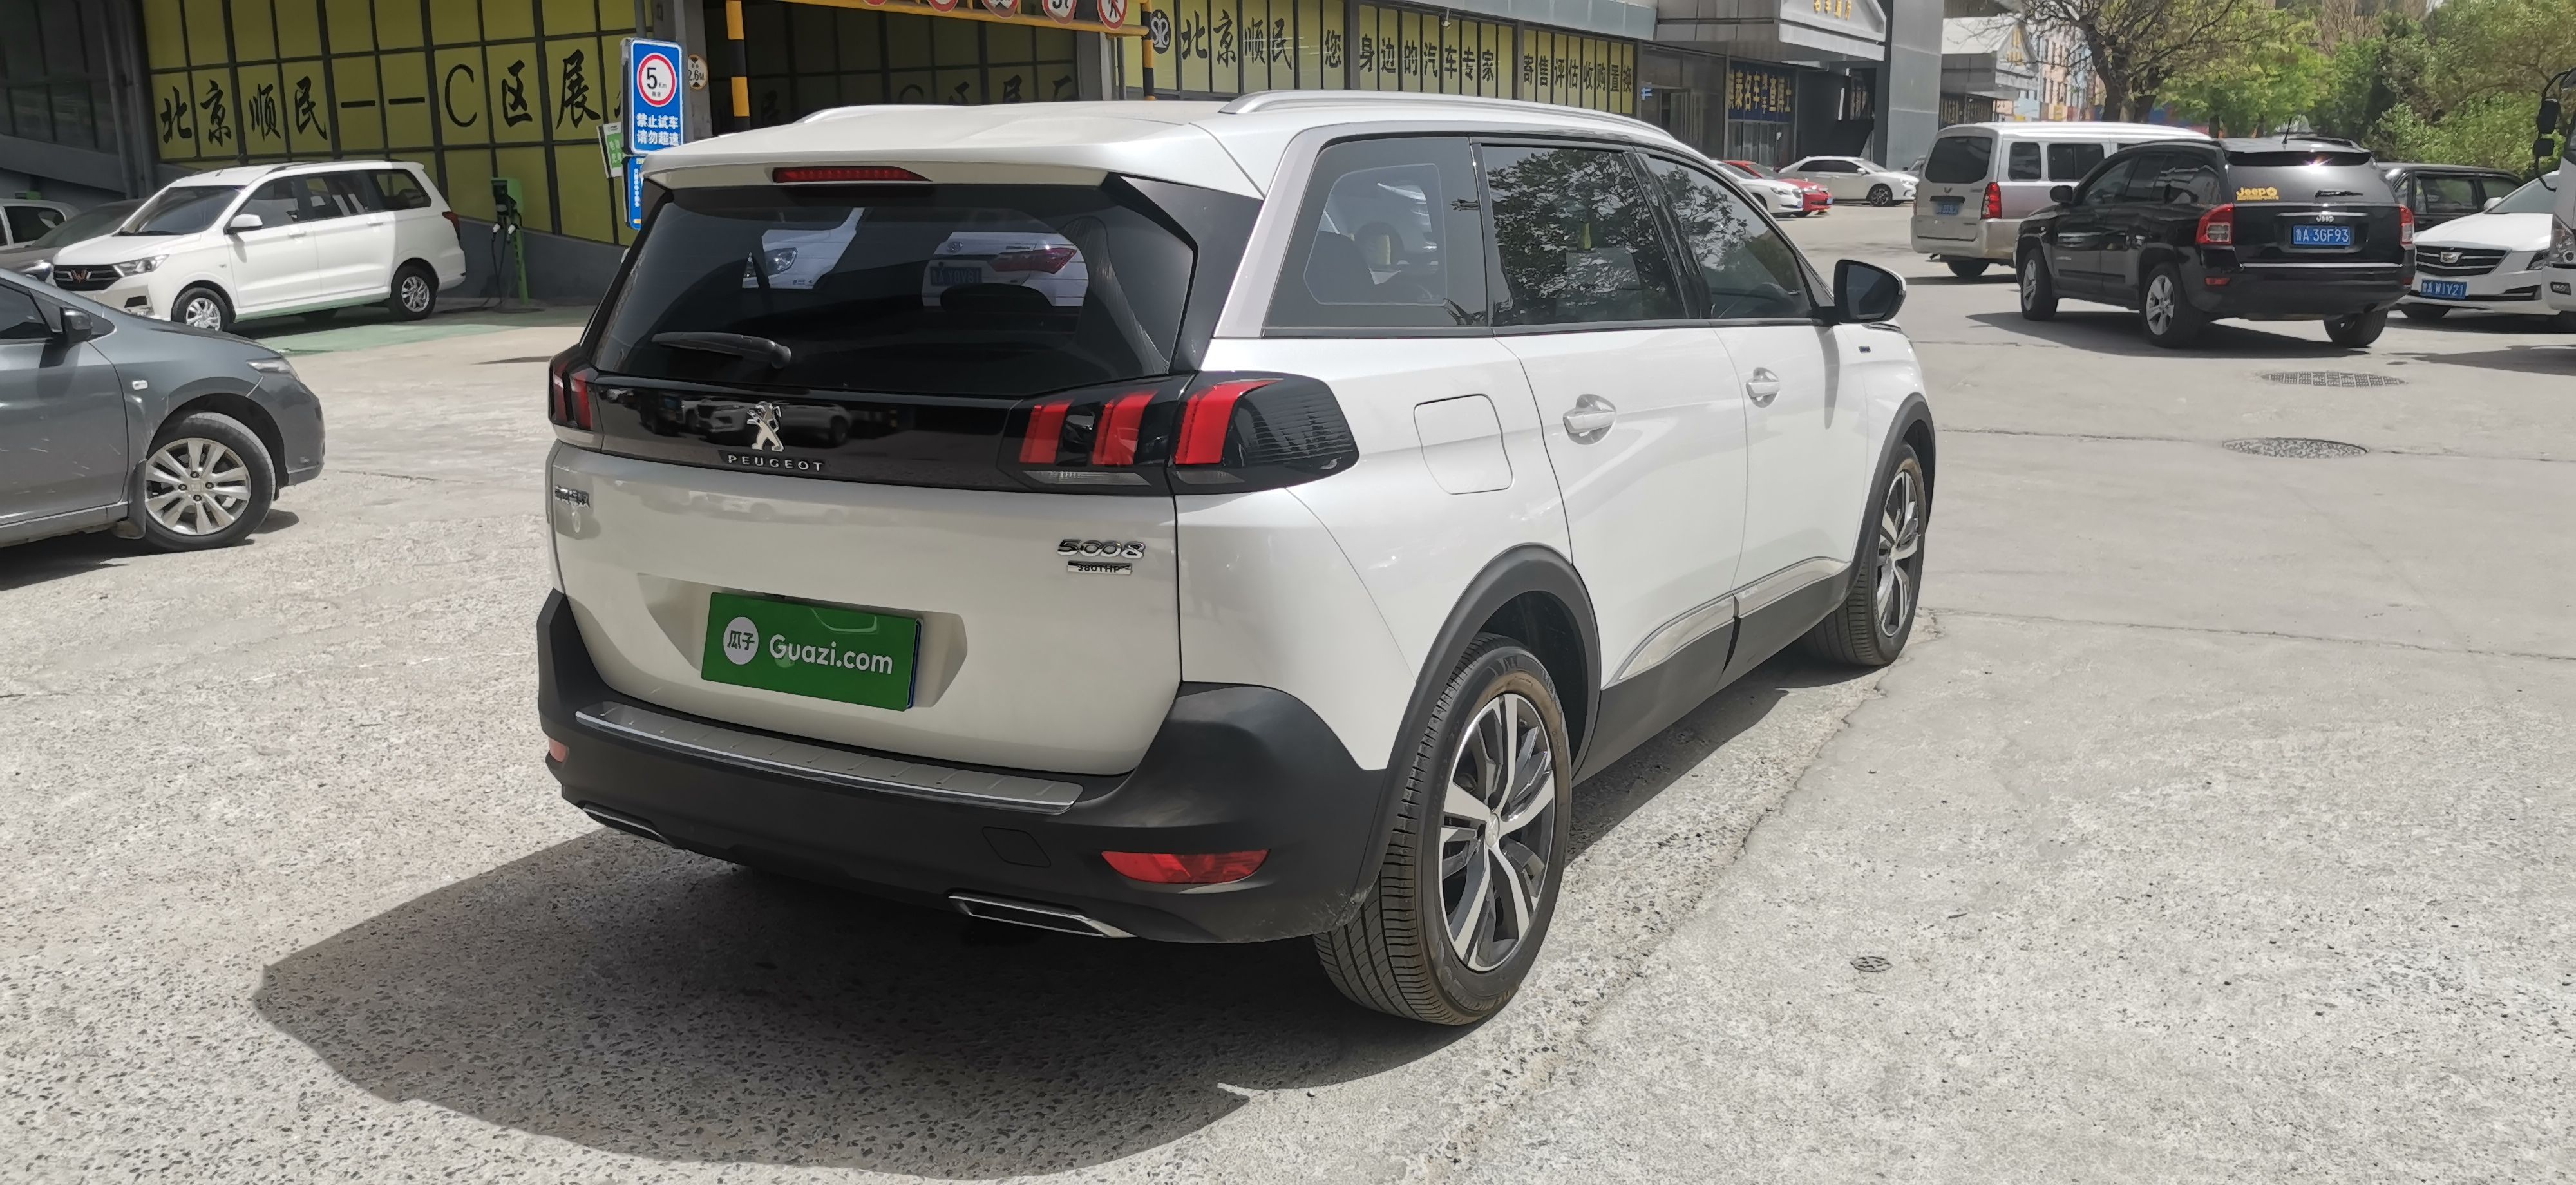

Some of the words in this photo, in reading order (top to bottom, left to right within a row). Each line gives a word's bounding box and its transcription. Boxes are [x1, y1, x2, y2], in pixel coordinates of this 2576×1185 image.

[1181, 9, 1293, 70] 北京顺民
[1524, 53, 1632, 93] 寄售评估收购置换
[647, 66, 658, 90] 5
[636, 113, 679, 130] 禁止试车
[637, 129, 679, 146] 请勿超速
[2236, 187, 2266, 196] Jeep
[2316, 214, 2334, 223] Jeep
[728, 455, 824, 471] PEUGEOT
[1057, 539, 1146, 559] 5008
[1077, 564, 1121, 573] 380THP
[727, 630, 755, 650] 瓜子
[769, 634, 893, 674] Guazi.com
